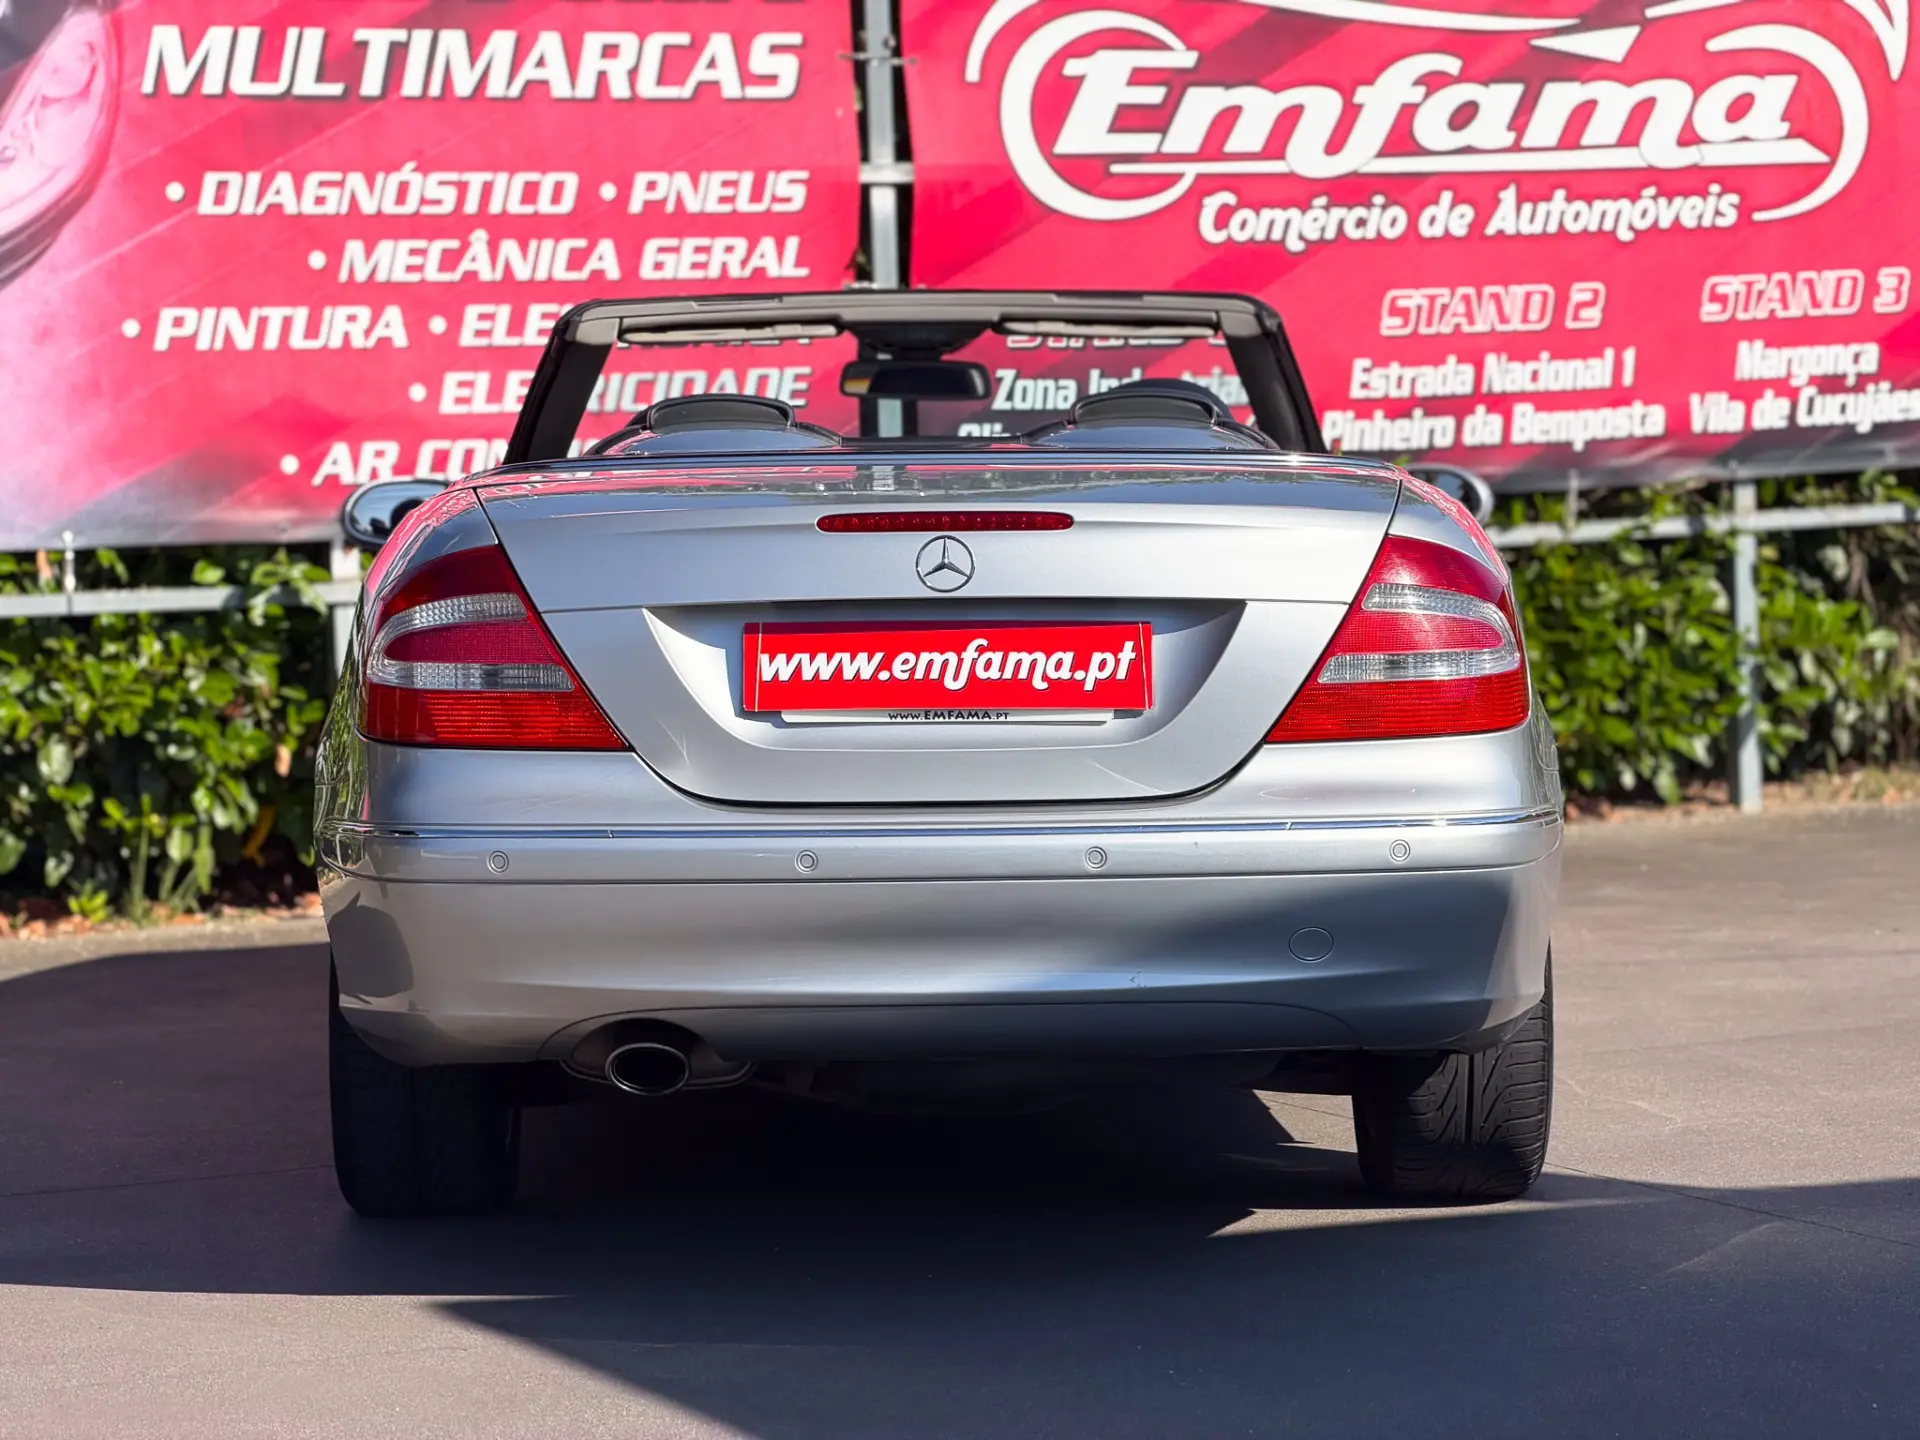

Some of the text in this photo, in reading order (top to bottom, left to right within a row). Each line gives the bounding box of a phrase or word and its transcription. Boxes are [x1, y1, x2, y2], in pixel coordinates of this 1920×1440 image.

[141, 25, 802, 101] MULTIMARCAS
[1052, 49, 1798, 178] Emfama
[198, 162, 809, 216] DIAGNÓSTICO PNEUS
[1199, 181, 1740, 253] Comércio de Automóveis
[338, 228, 810, 283] MECÂNICA GERAL
[1380, 281, 1607, 337] STAND 2
[1700, 267, 1911, 322] STAND 3
[153, 305, 410, 351] PINTURA
[991, 368, 1078, 411] Zona
[1349, 346, 1636, 399] Estrada Nacional 1
[1322, 399, 1666, 452] Pinheiro da Bemposta
[1689, 391, 1746, 434] Vila
[1752, 388, 1791, 430] de
[311, 440, 400, 487] AR
[760, 638, 1137, 691] www.emfama.pt
